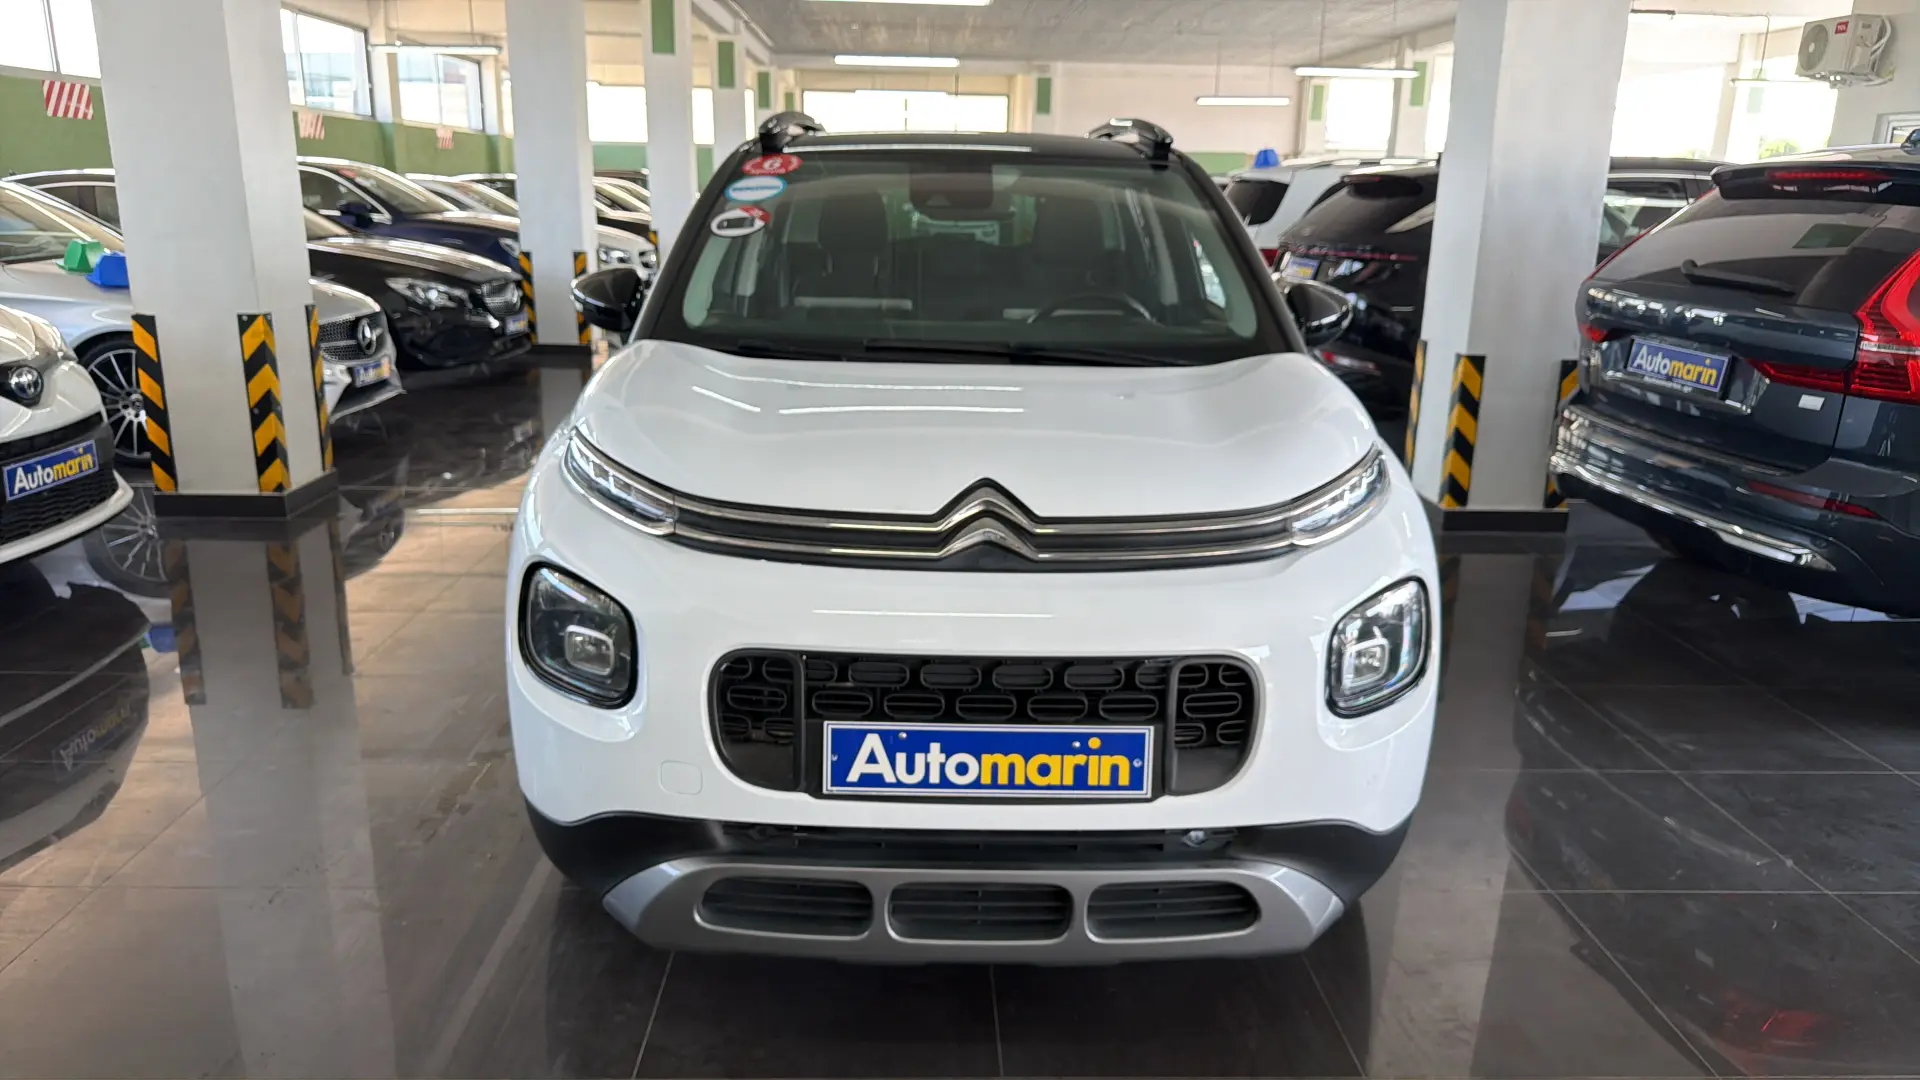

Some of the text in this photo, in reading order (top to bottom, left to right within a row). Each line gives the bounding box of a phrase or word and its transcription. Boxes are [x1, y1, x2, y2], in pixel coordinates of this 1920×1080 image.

[1633, 344, 1718, 387] Automarin
[13, 446, 94, 495] Automarin
[845, 732, 1131, 787] Automarin
